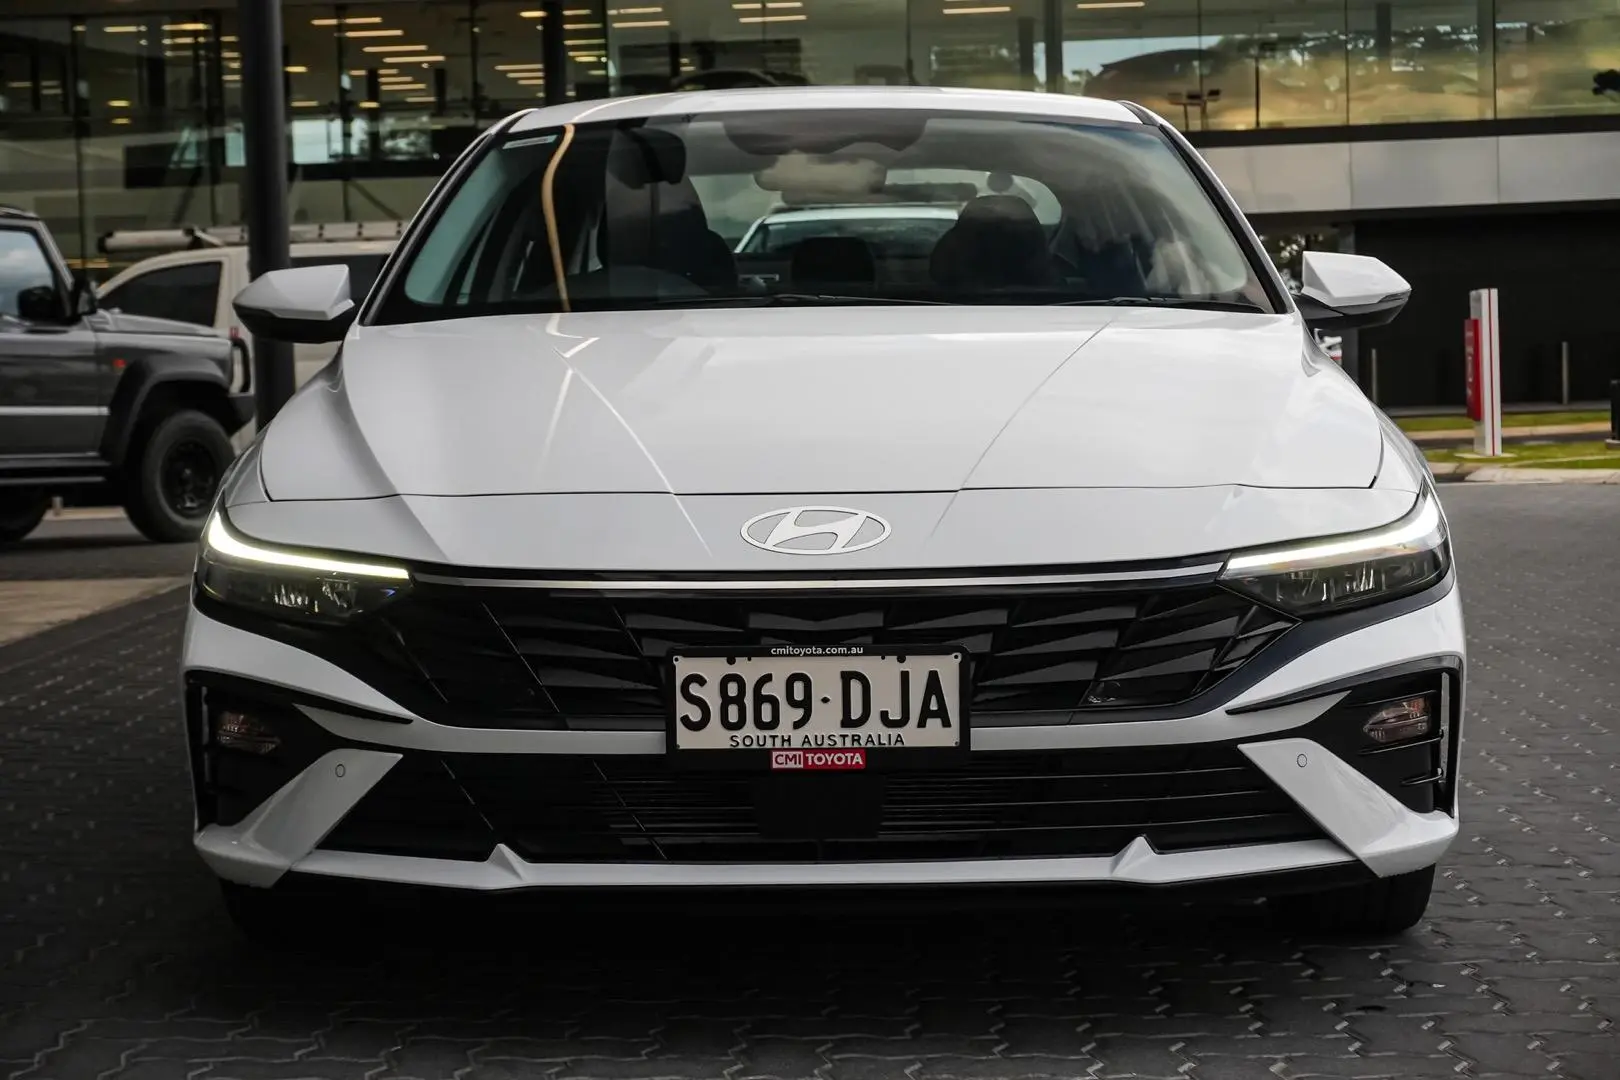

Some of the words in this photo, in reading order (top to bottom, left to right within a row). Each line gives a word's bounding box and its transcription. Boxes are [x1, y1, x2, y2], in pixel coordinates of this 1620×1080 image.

[771, 645, 864, 657] cmitoyota.com.au
[729, 734, 792, 748] SOUTH
[801, 733, 905, 747] AUSTRALIA
[773, 753, 802, 766] CMI
[805, 752, 864, 766] TOYOTA
